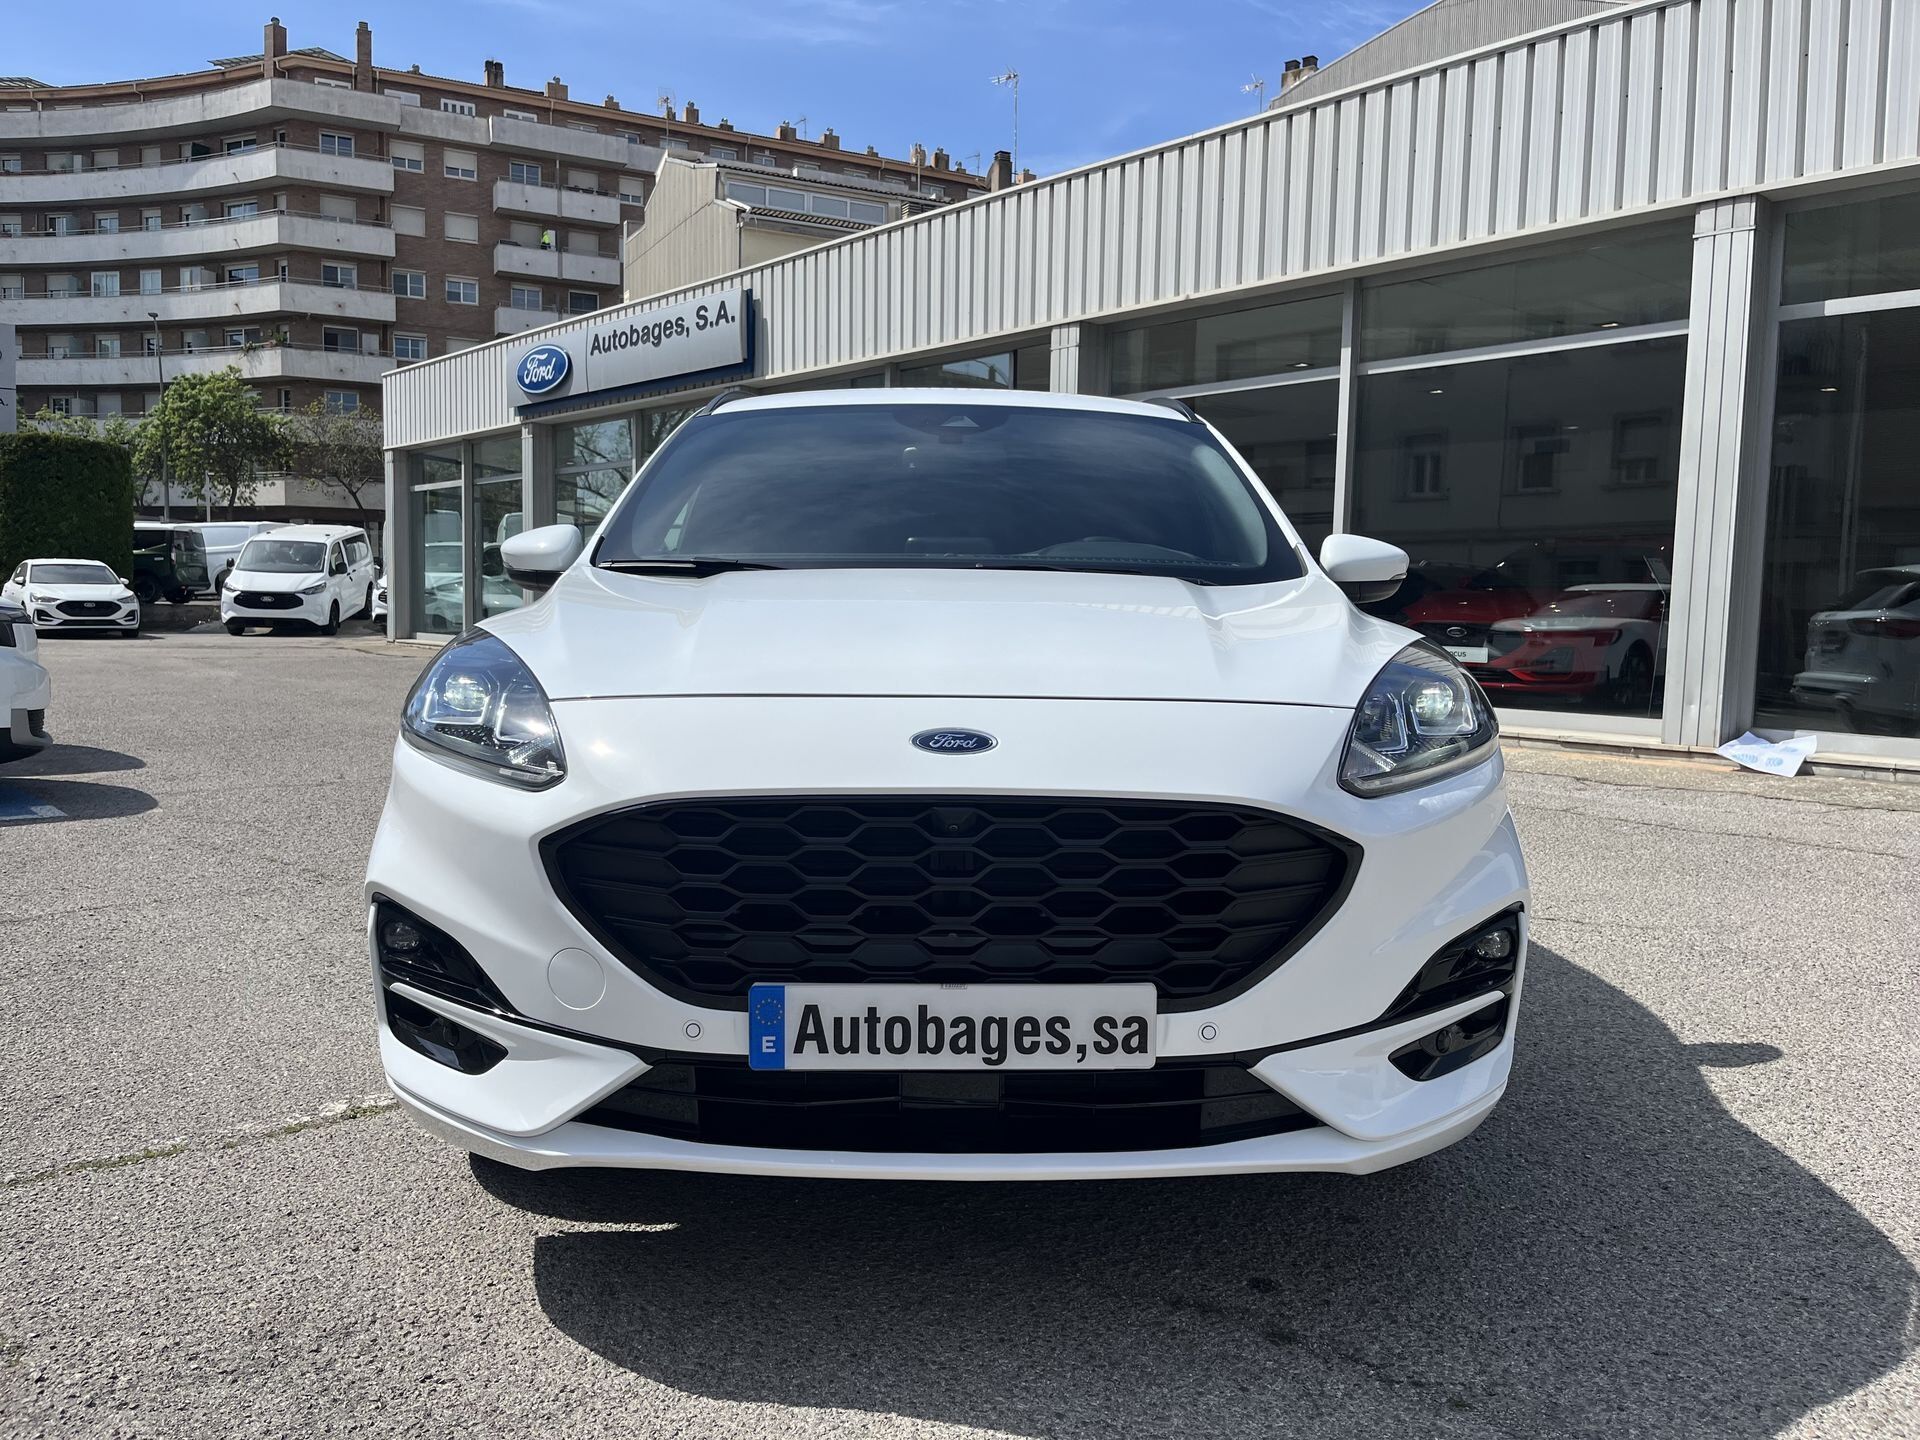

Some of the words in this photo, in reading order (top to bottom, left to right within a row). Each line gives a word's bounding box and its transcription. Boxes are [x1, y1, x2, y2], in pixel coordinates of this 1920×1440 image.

[590, 316, 690, 355] Autobages,
[695, 300, 736, 330] S.A.
[524, 352, 555, 385] Ford
[929, 733, 978, 748] Ford
[762, 1036, 776, 1053] E
[793, 1004, 1149, 1066] Autobages,sa
